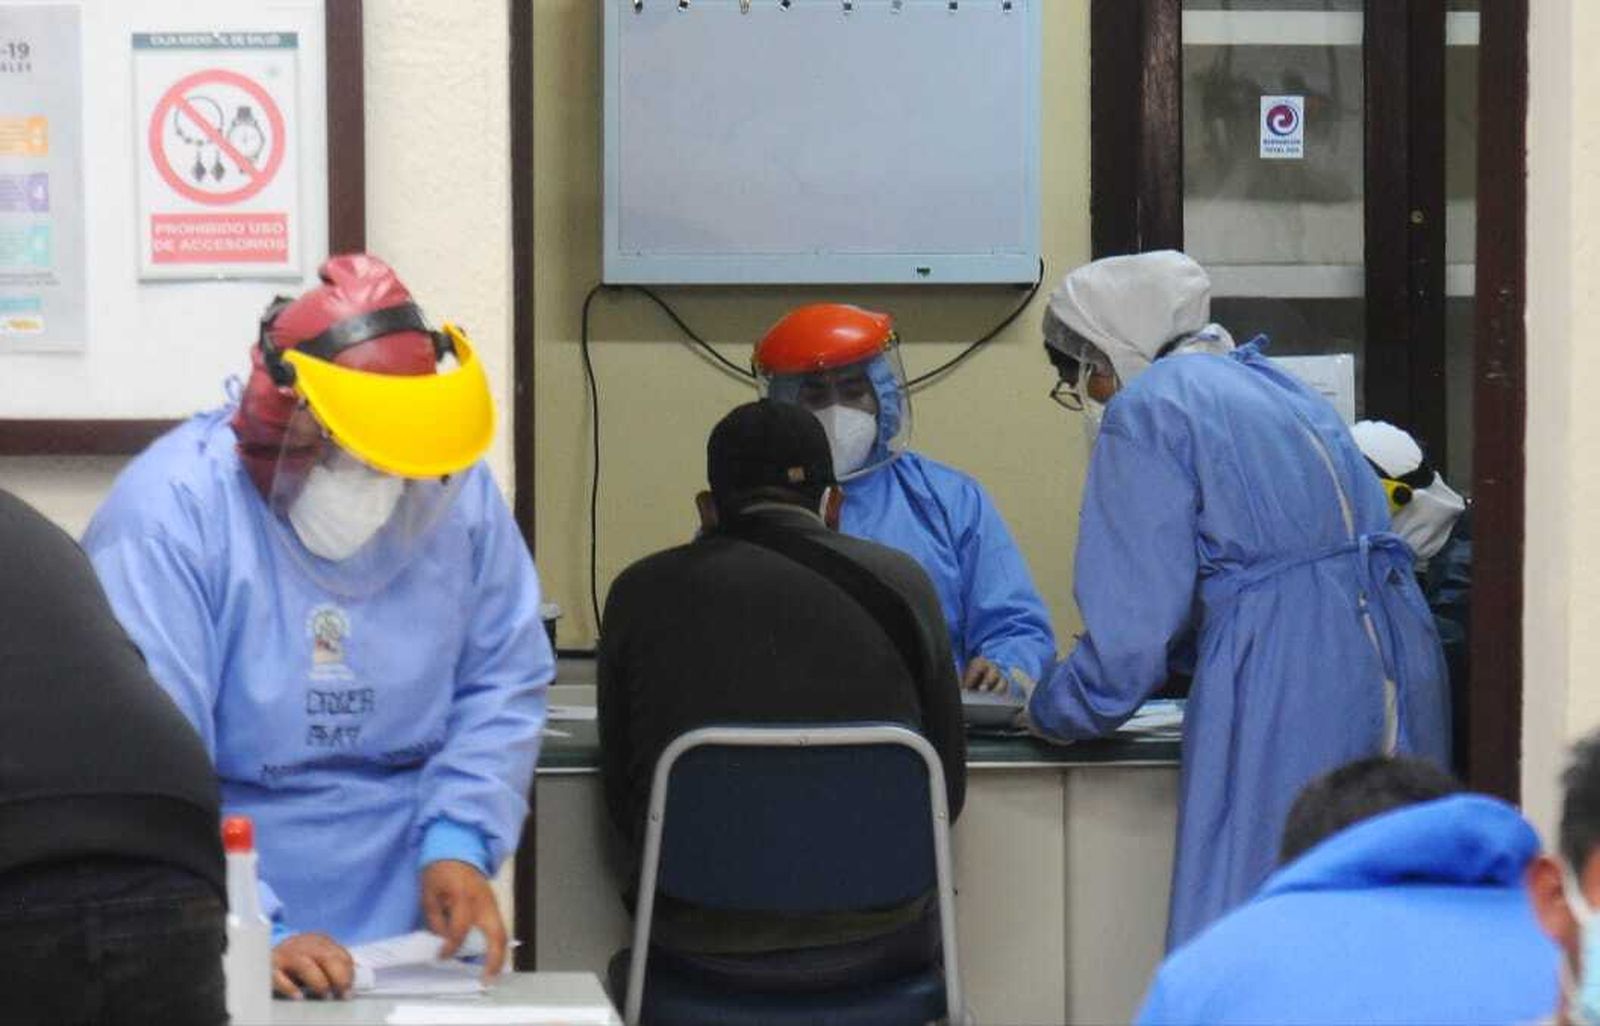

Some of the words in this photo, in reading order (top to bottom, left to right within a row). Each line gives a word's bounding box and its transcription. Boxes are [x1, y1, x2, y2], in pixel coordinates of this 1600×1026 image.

[154, 222, 245, 235] PROHIBIDO
[247, 222, 286, 235] USO
[153, 238, 174, 252] DE
[178, 238, 287, 251] ACCESORIOS
